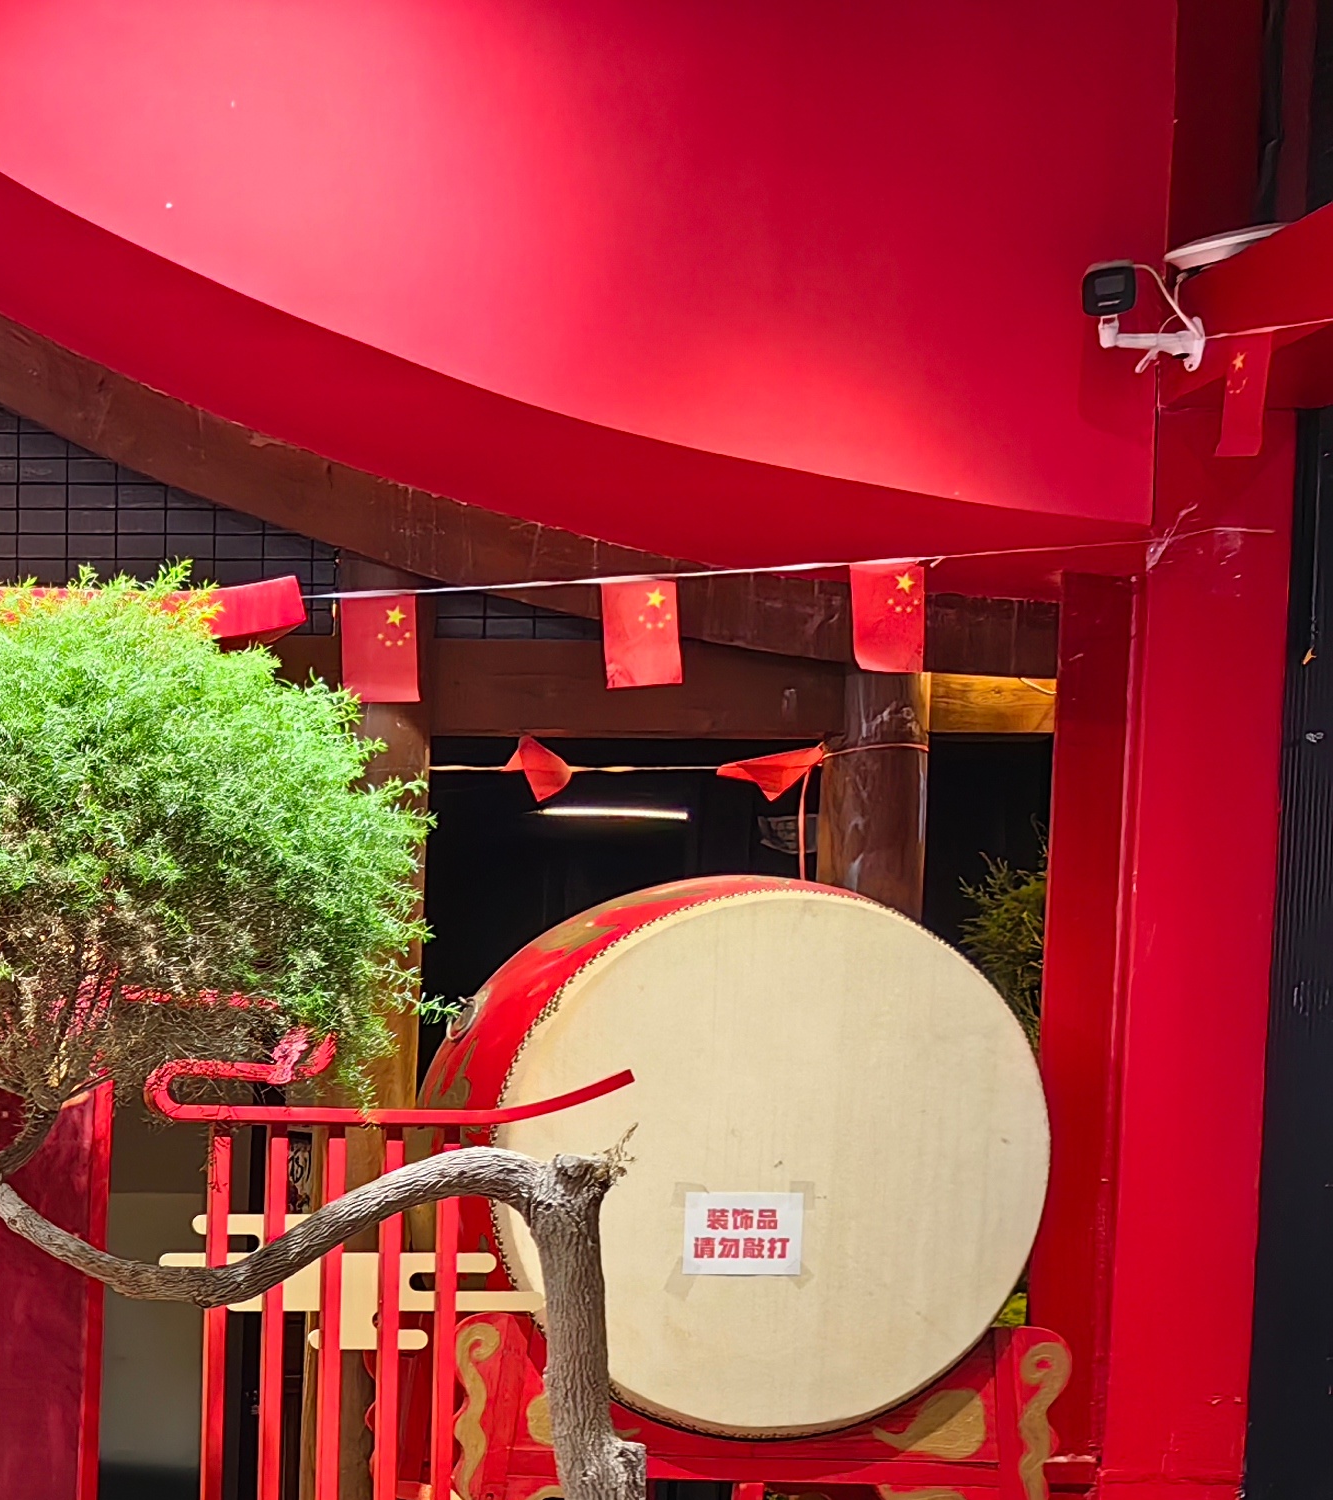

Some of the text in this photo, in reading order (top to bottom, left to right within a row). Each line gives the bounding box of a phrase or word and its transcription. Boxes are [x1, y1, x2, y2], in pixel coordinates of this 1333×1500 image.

[707, 1208, 778, 1230] 装饰品
[693, 1237, 790, 1259] 请勿敲打
